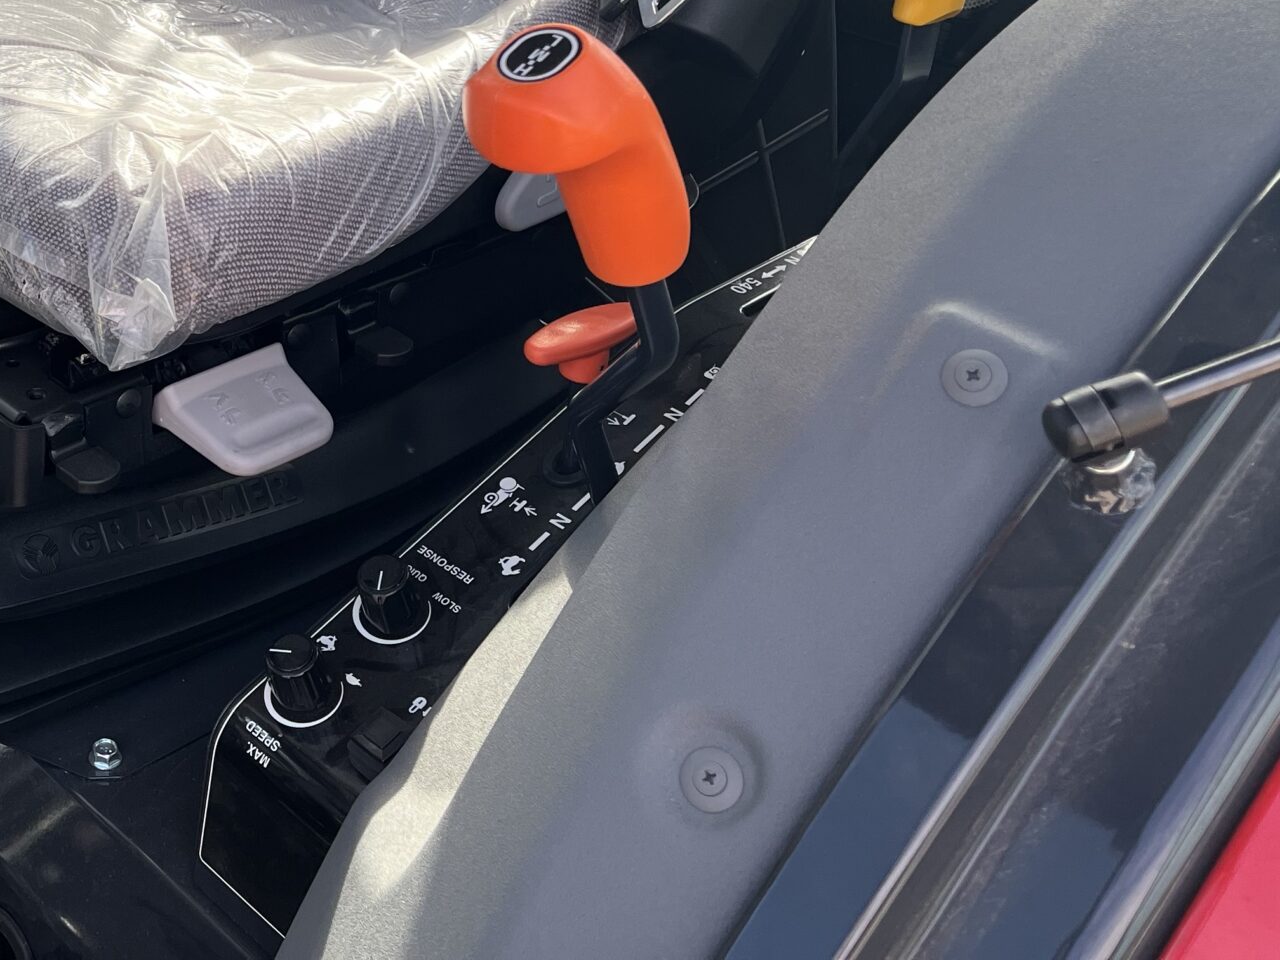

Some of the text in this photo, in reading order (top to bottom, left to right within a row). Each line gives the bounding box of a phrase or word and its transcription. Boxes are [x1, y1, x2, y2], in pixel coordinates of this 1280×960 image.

[730, 277, 762, 294] 540
[663, 407, 685, 422] N
[71, 471, 299, 558] GRAMMER
[548, 512, 572, 530] N
[416, 544, 474, 585] RESPONSE
[431, 592, 462, 614] SLOW
[245, 720, 281, 752] SPEED
[246, 741, 271, 768] MAX.
